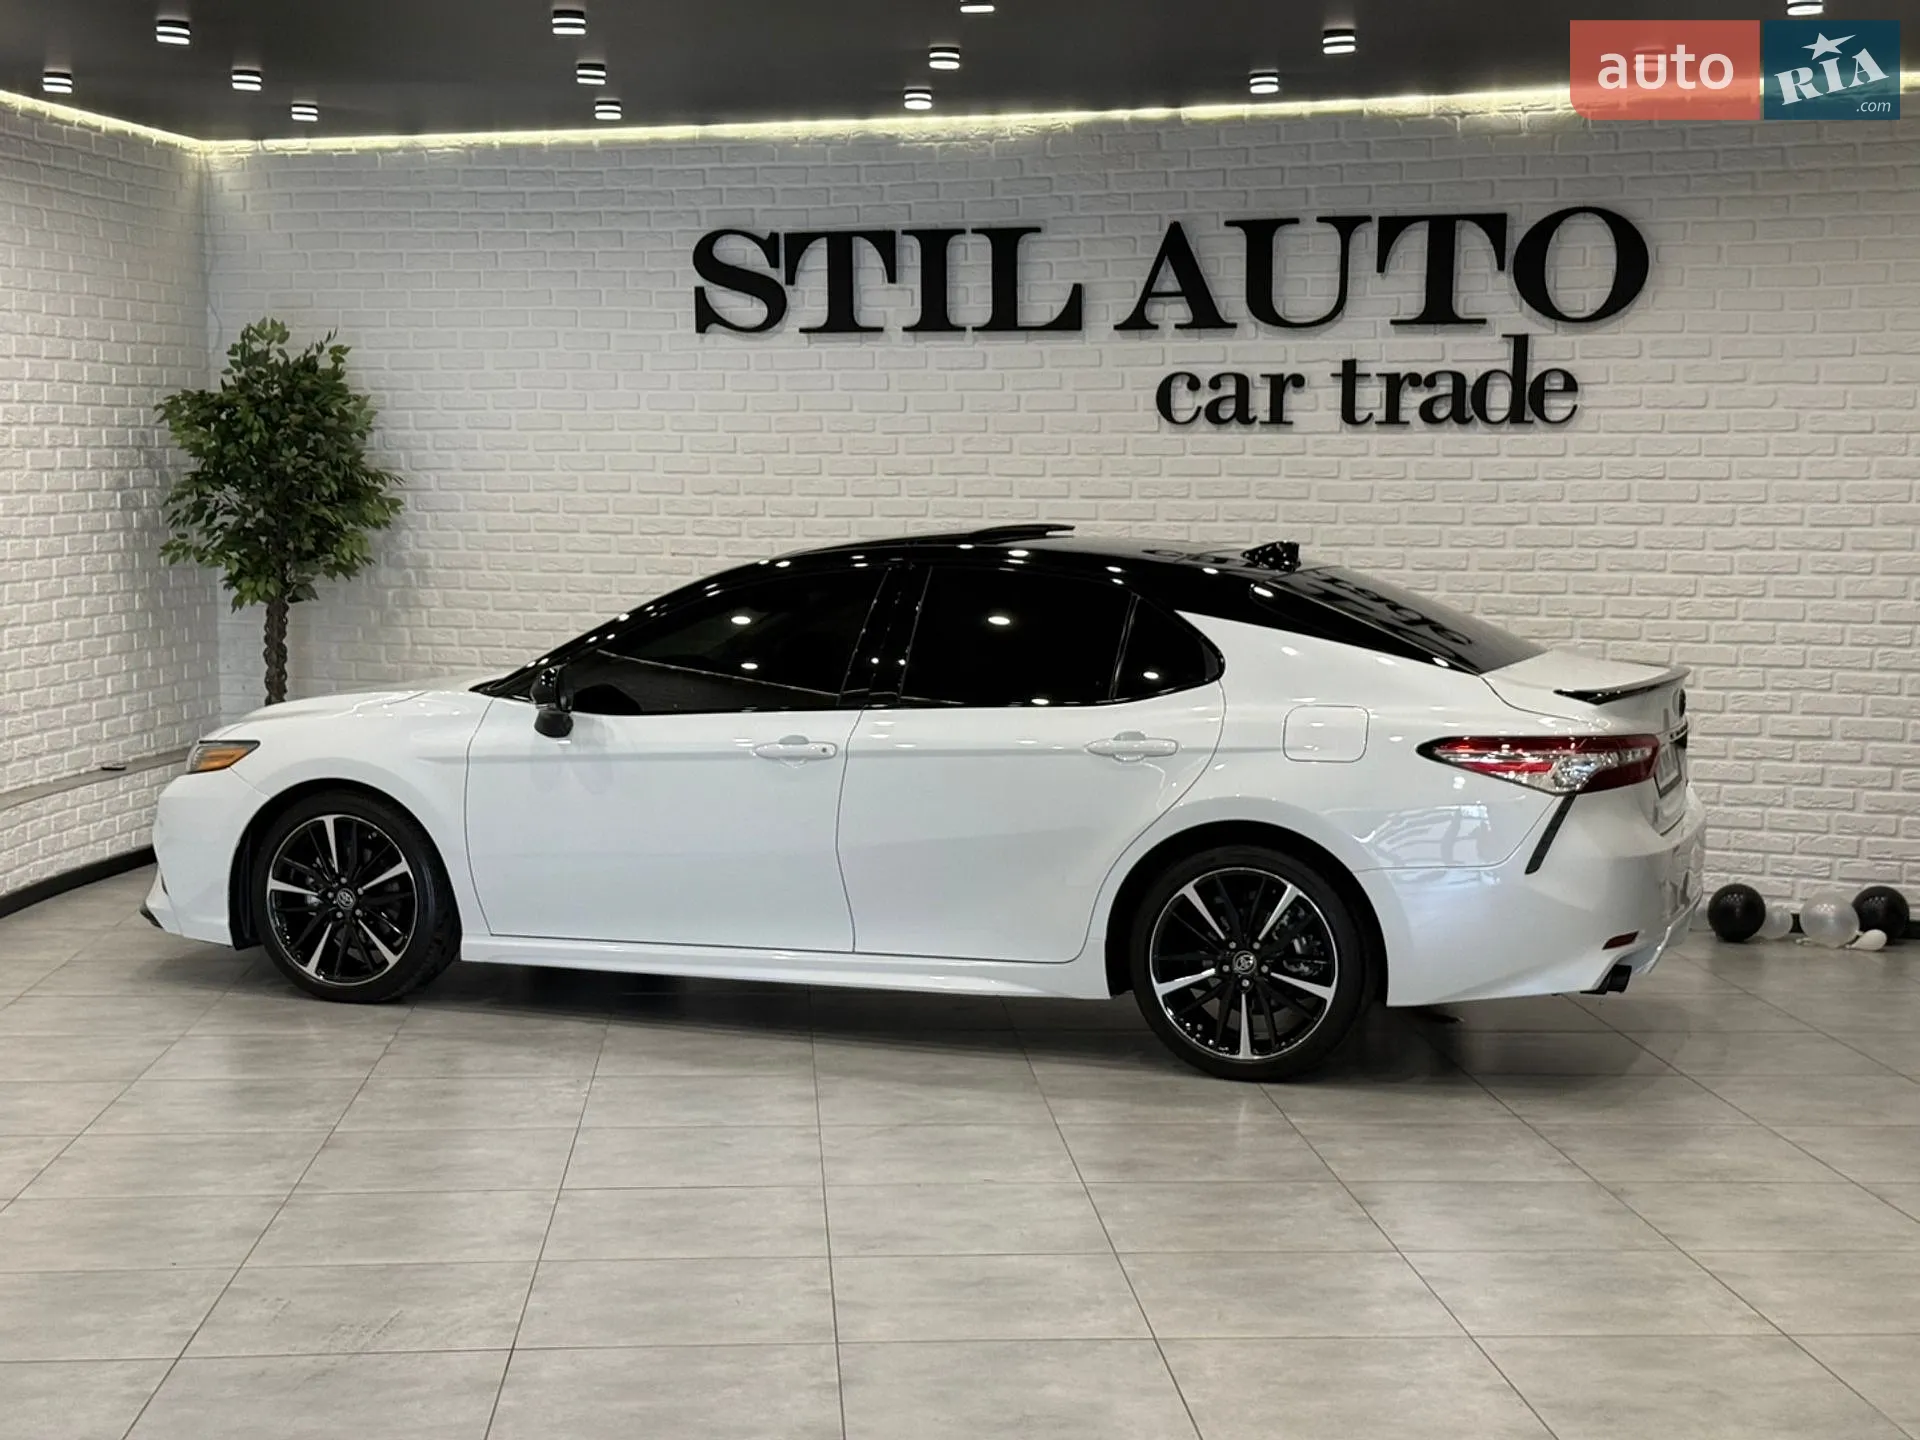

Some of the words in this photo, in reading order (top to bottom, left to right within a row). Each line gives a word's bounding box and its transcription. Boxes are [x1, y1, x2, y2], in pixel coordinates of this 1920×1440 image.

[692, 226, 1082, 334] STIL
[1113, 206, 1650, 330] AUTO
[1155, 370, 1306, 426] car
[1331, 333, 1579, 426] trade
